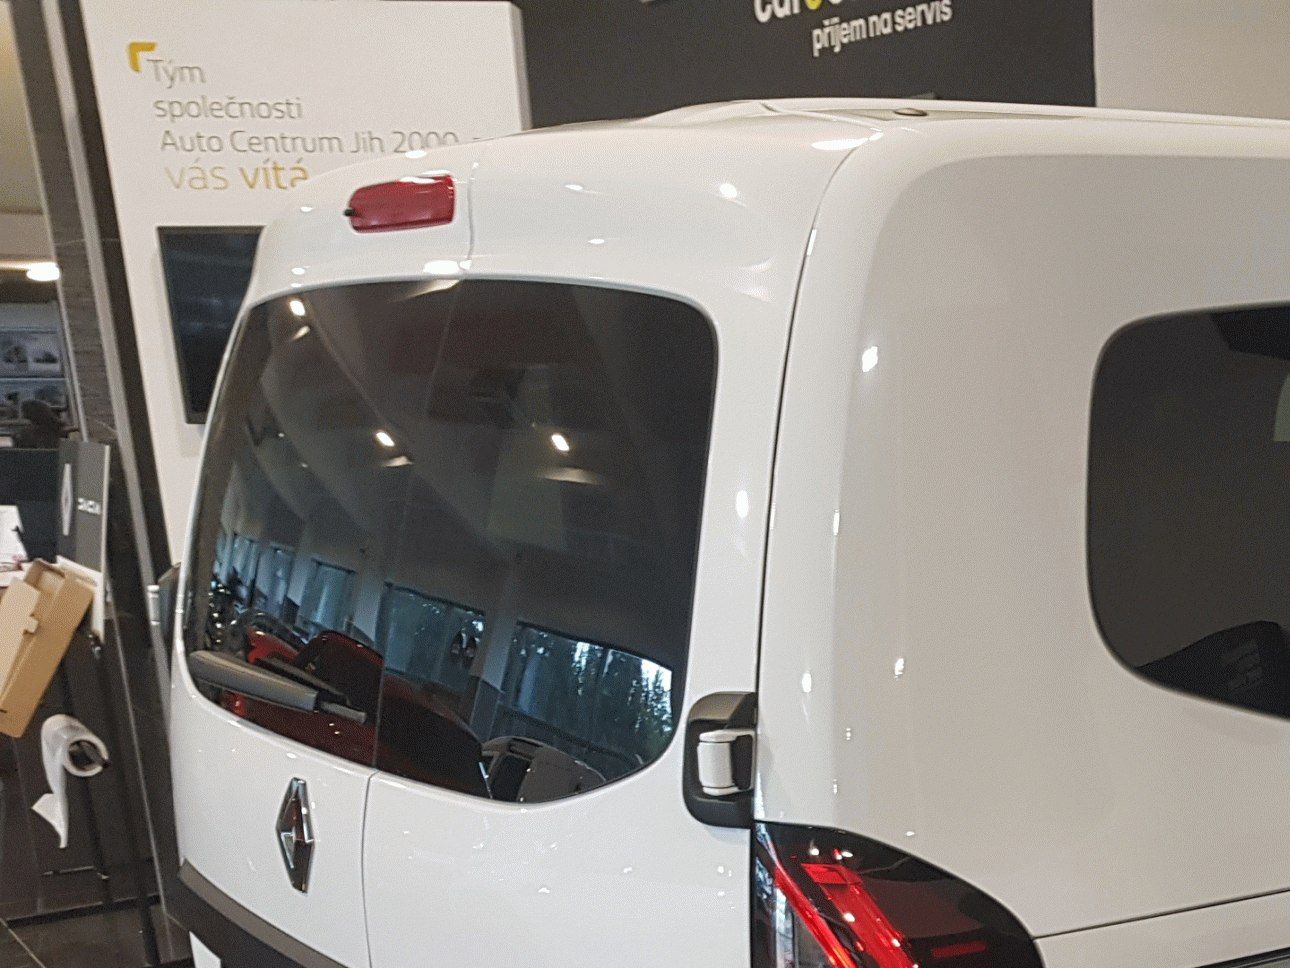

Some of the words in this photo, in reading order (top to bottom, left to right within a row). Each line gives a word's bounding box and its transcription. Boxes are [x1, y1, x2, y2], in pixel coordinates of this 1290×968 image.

[868, 12, 894, 38] na
[894, 0, 953, 32] servis
[146, 59, 207, 89] Tým
[153, 95, 304, 123] společnosti
[160, 130, 224, 153] Auto
[230, 130, 343, 153] Centrum
[350, 131, 384, 153] Jih
[392, 131, 460, 153] 2000
[164, 157, 229, 190] vás
[239, 157, 310, 190] vítá
